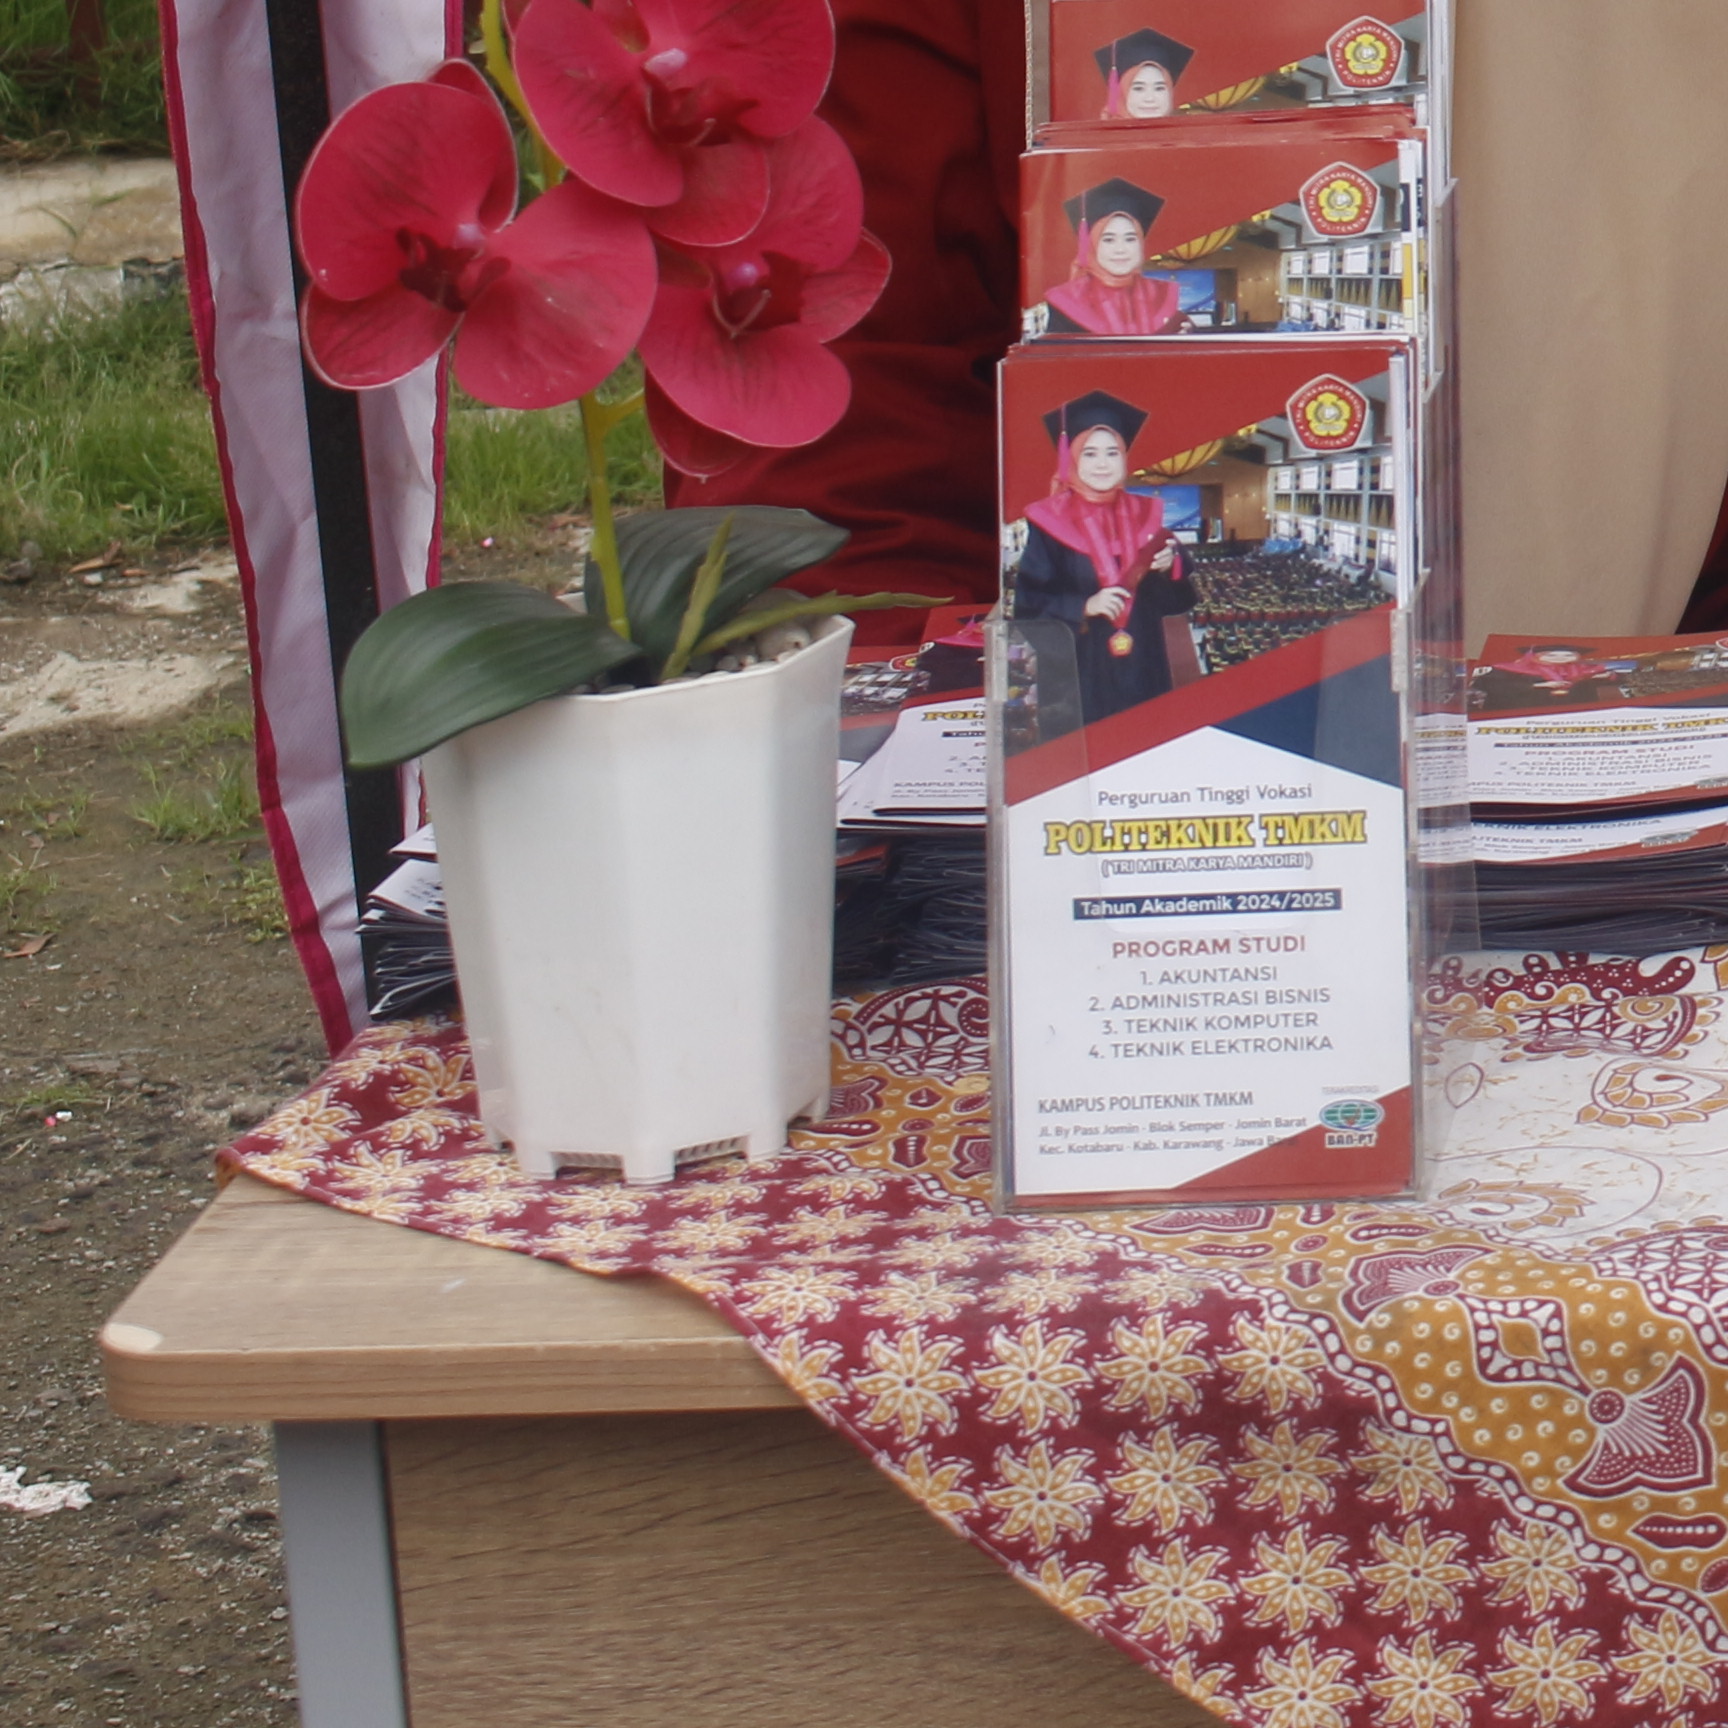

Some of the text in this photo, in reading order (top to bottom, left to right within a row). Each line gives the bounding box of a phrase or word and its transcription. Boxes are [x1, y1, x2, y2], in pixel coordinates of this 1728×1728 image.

[1097, 783, 1313, 810] Perguruan Tinggi Vokasi
[1044, 810, 1368, 855] POLITEKNIK TMKM
[1137, 857, 1184, 873] MITRA
[1187, 855, 1234, 871] KARYA
[1081, 891, 1336, 916] Tahun Akademik 2024/2025
[1111, 935, 1307, 959] PROGRAM STUDI
[1140, 965, 1278, 986] 1. AKUNTANSI
[1088, 987, 1331, 1012] 2. ADMINISTRASI BISNIS
[1102, 1011, 1319, 1035] 3. TEKNIK KOMPUTER
[1088, 1035, 1334, 1059] 4. TEKNIK ELEKTRONIKA
[1038, 1090, 1254, 1114] KAMPUS POLITEKNIK TMKM
[1055, 1126, 1070, 1138] By
[1073, 1125, 1100, 1136] Pass
[1102, 1123, 1140, 1135] Jomin
[1149, 1121, 1176, 1133] Blok
[1179, 1121, 1225, 1133] Semper
[1235, 1117, 1272, 1130] Jomin
[1275, 1117, 1307, 1128] Barat
[1326, 1132, 1376, 1147] BAN-PT
[1067, 1142, 1124, 1154] Kotabaru
[1133, 1139, 1160, 1151] Kab.
[1163, 1137, 1224, 1151] Karawang
[1233, 1136, 1264, 1148] Jawa
